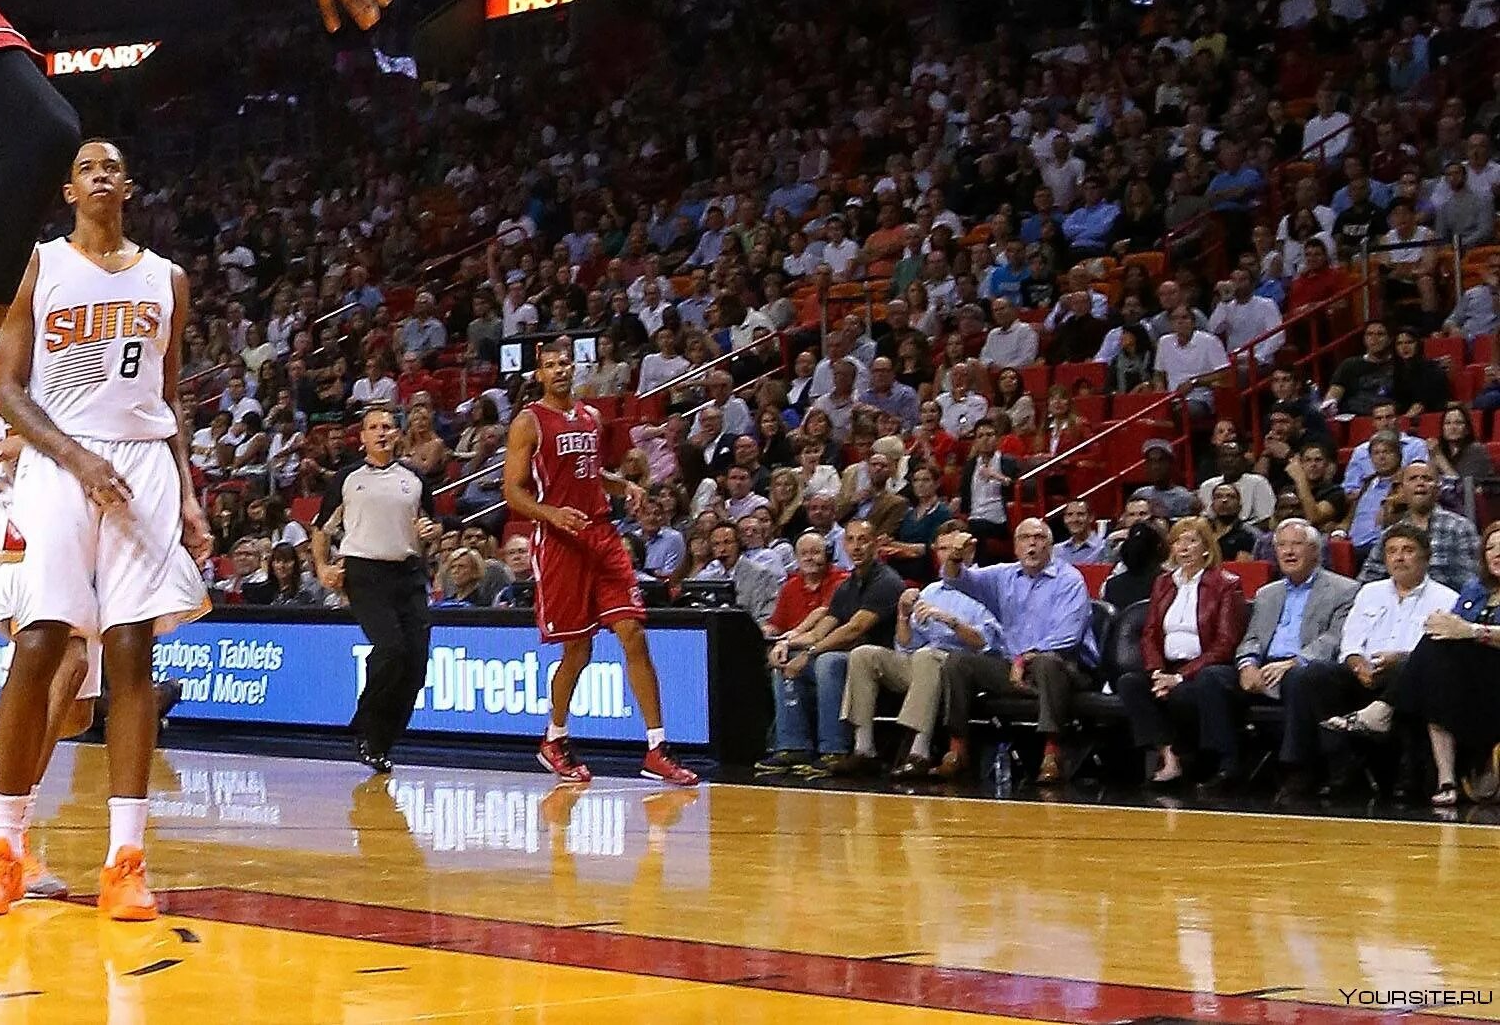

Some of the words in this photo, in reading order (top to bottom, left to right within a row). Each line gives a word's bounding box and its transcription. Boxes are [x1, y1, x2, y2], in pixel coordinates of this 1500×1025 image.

[121, 341, 141, 378] 8
[151, 639, 214, 672] aptops,
[218, 639, 283, 671] Tablets
[212, 673, 268, 705] More!
